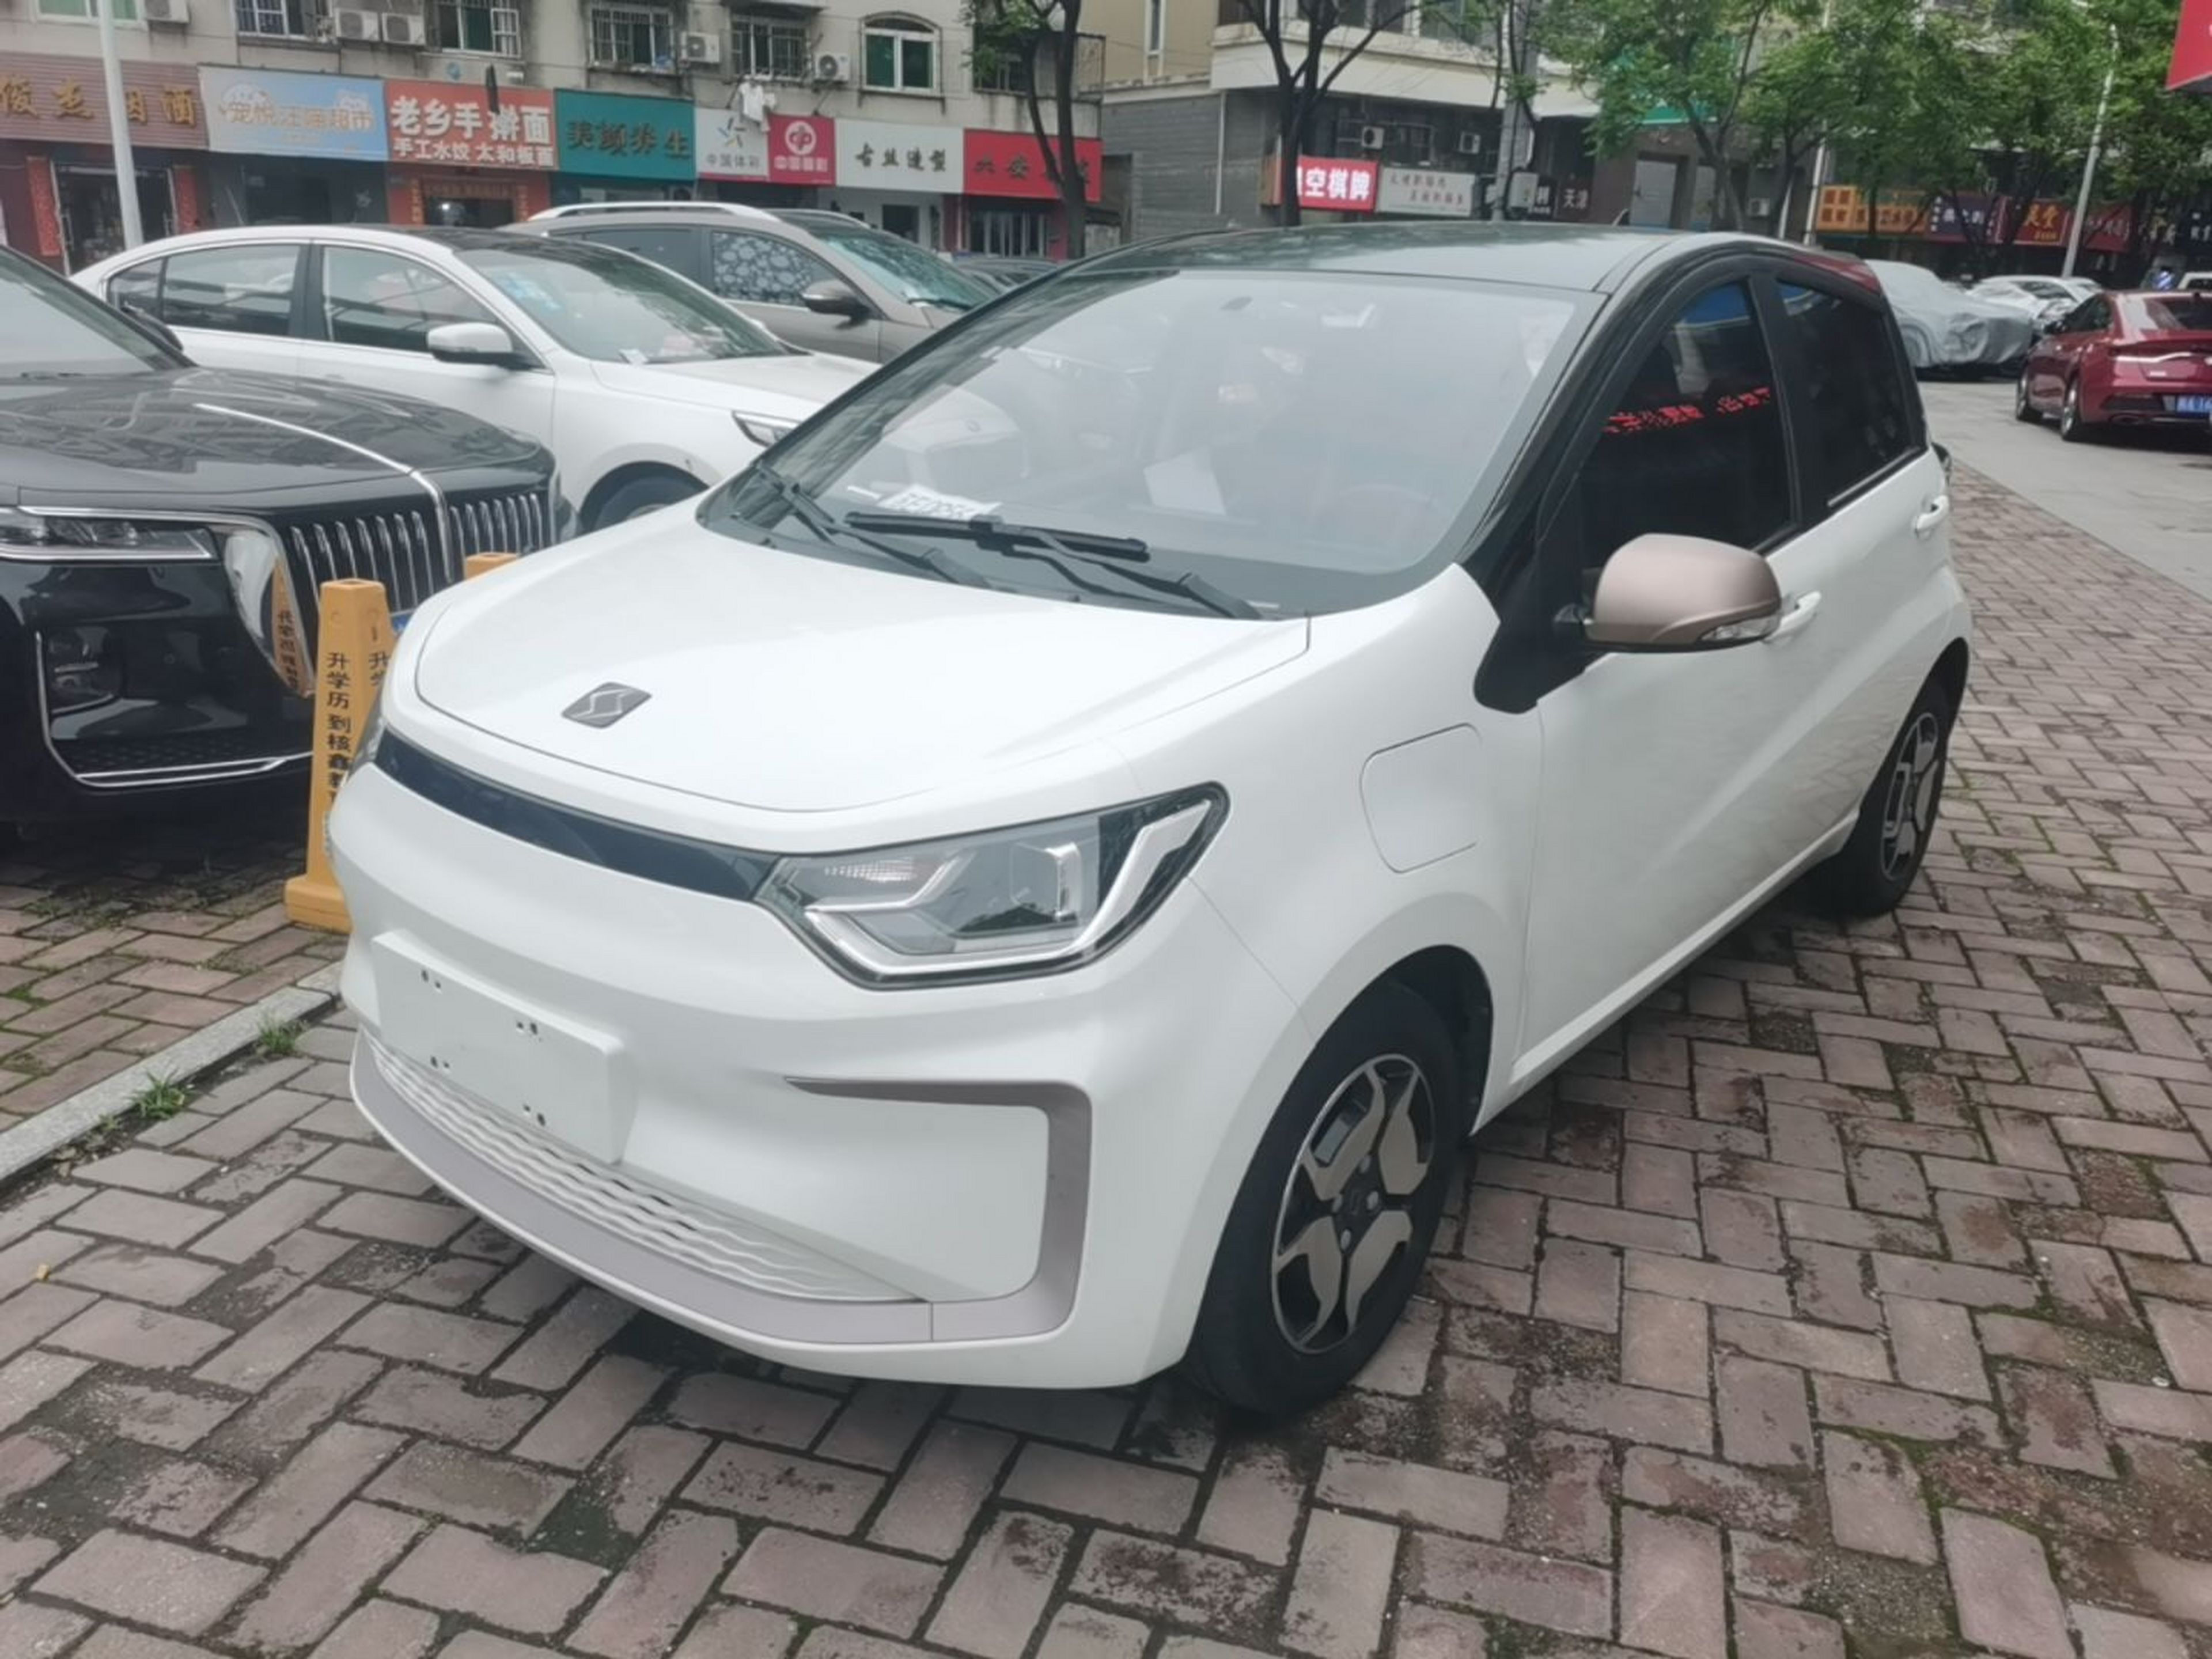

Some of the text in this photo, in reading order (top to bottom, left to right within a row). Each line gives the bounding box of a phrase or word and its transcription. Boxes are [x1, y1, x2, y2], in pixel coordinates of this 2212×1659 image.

[391, 96, 550, 143] 老乡手擀面
[393, 138, 469, 161] 手工水饺
[706, 153, 760, 168] 中国体彩
[1297, 165, 1370, 200] 空棋牌
